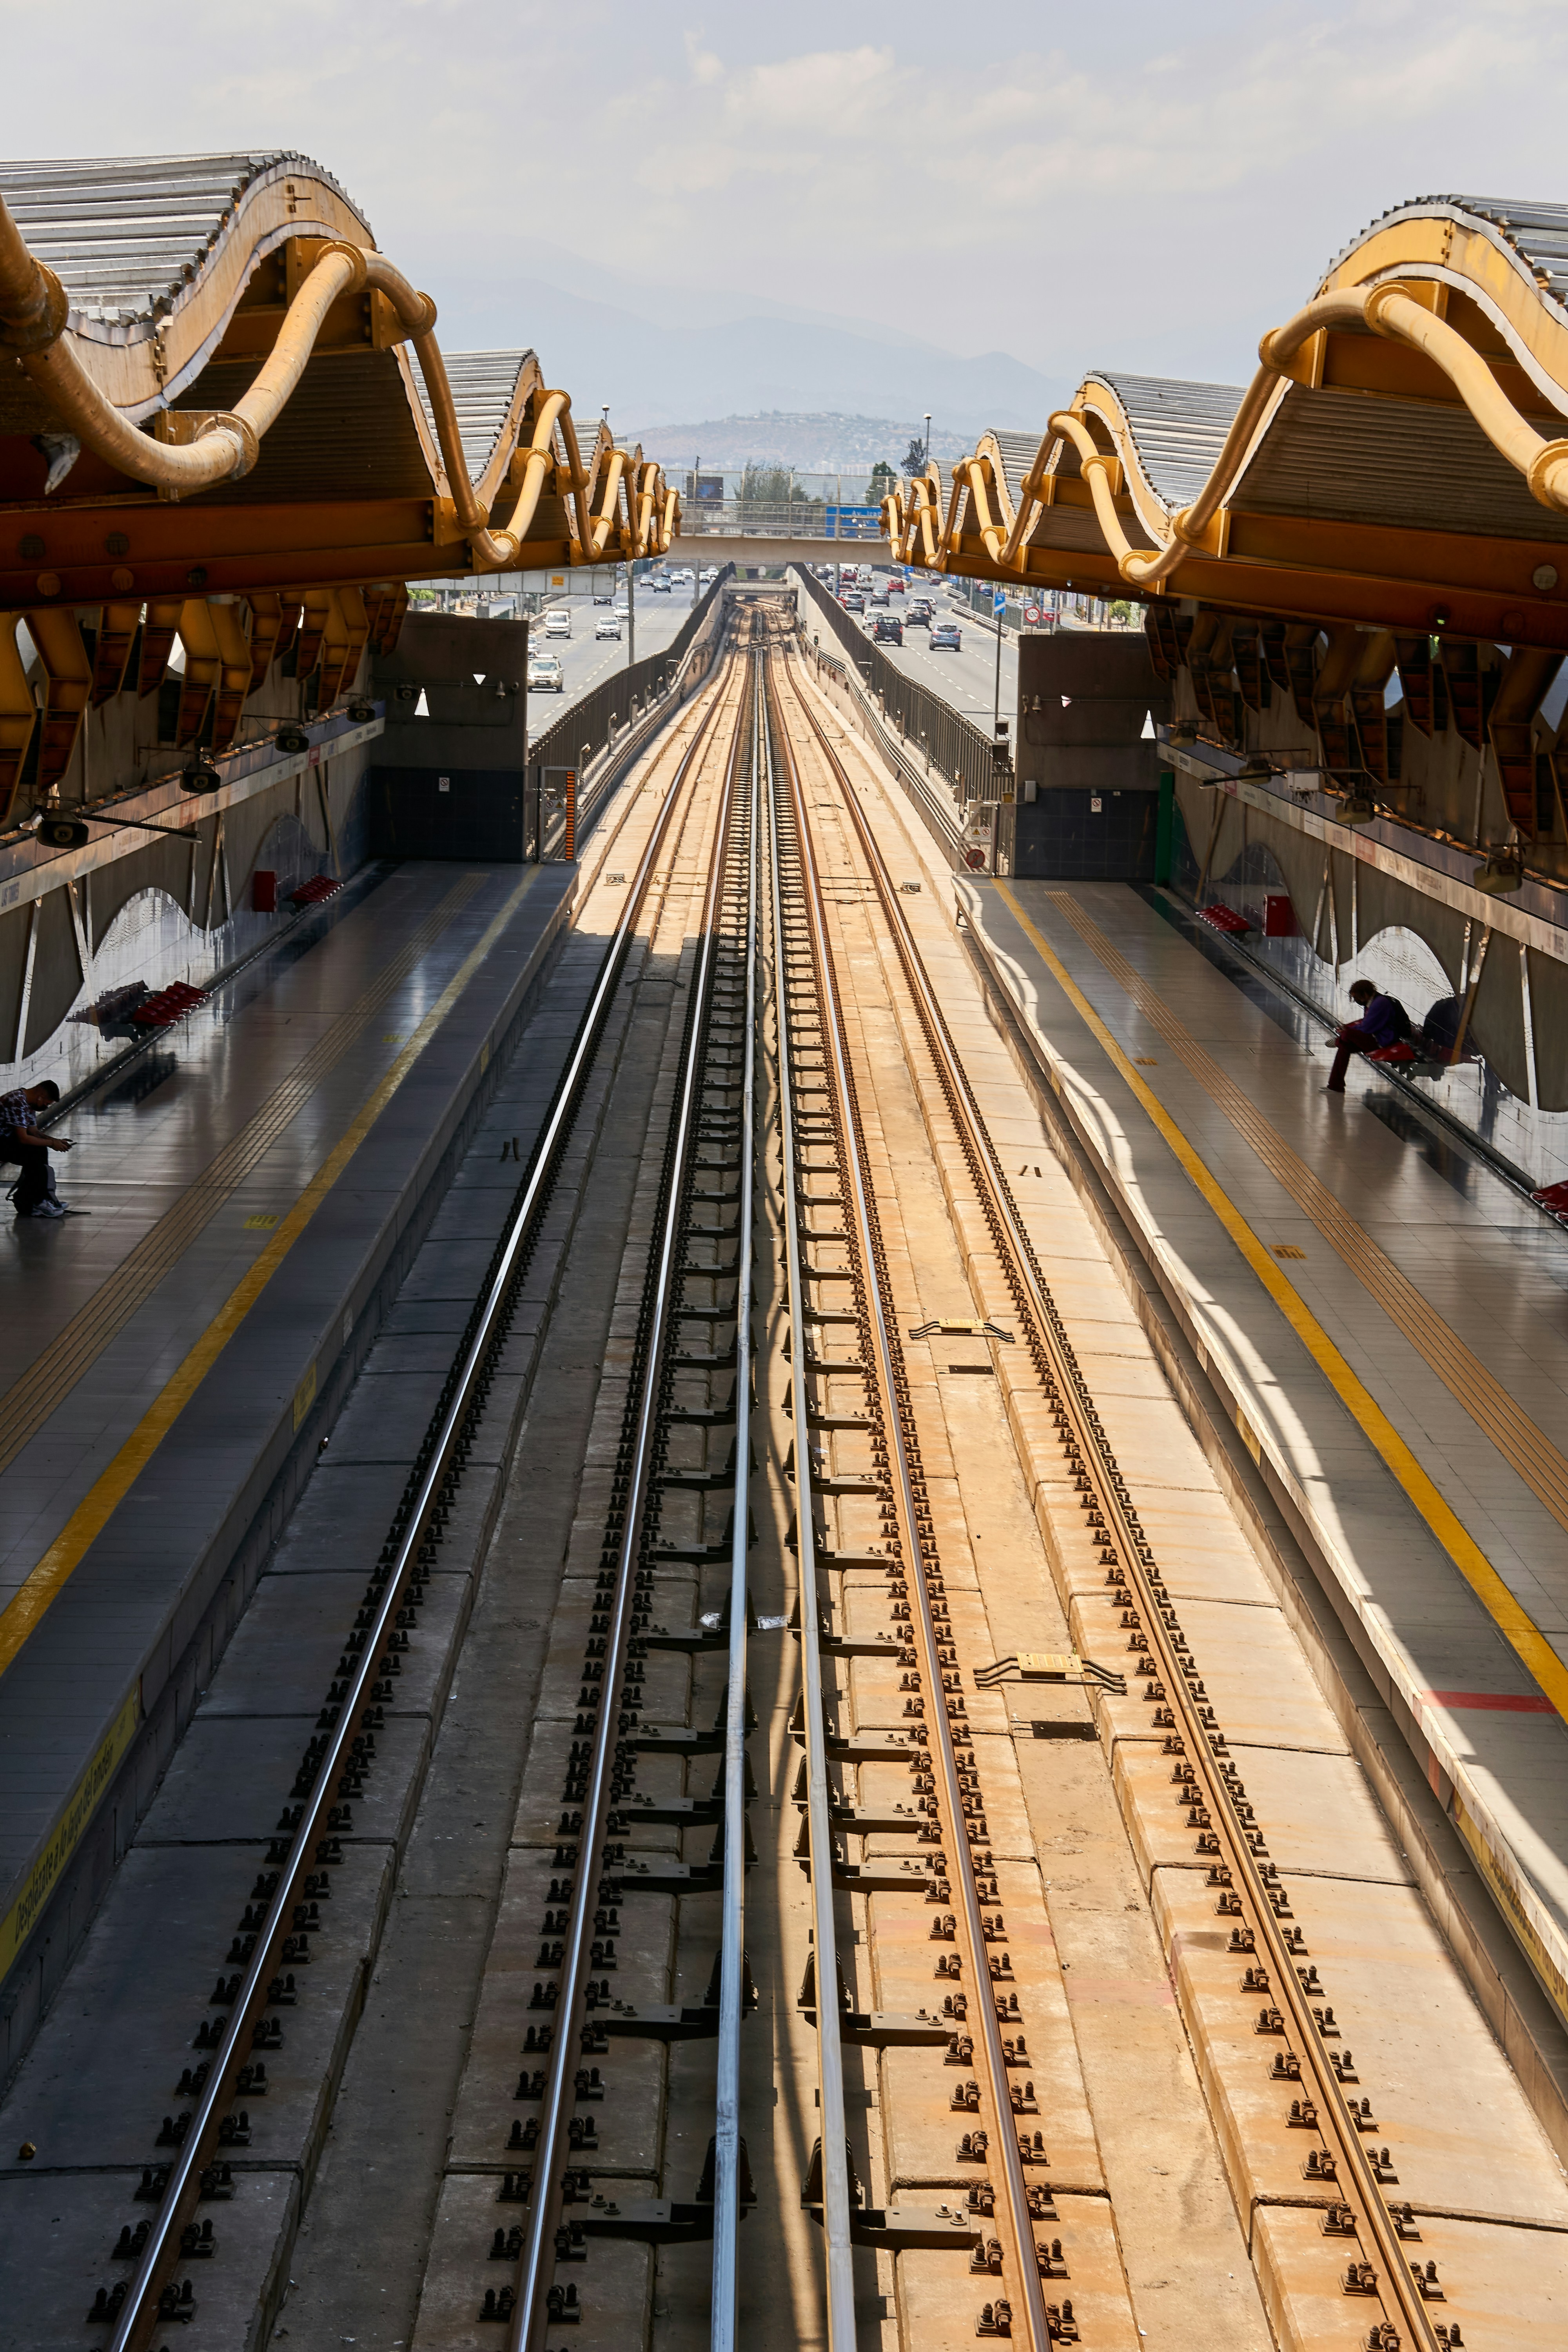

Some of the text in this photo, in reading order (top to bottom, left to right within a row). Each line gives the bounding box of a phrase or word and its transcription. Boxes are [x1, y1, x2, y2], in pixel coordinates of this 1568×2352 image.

[15, 1851, 53, 1944] Desplázate
[54, 1843, 59, 1872] a
[59, 1824, 67, 1862] lo
